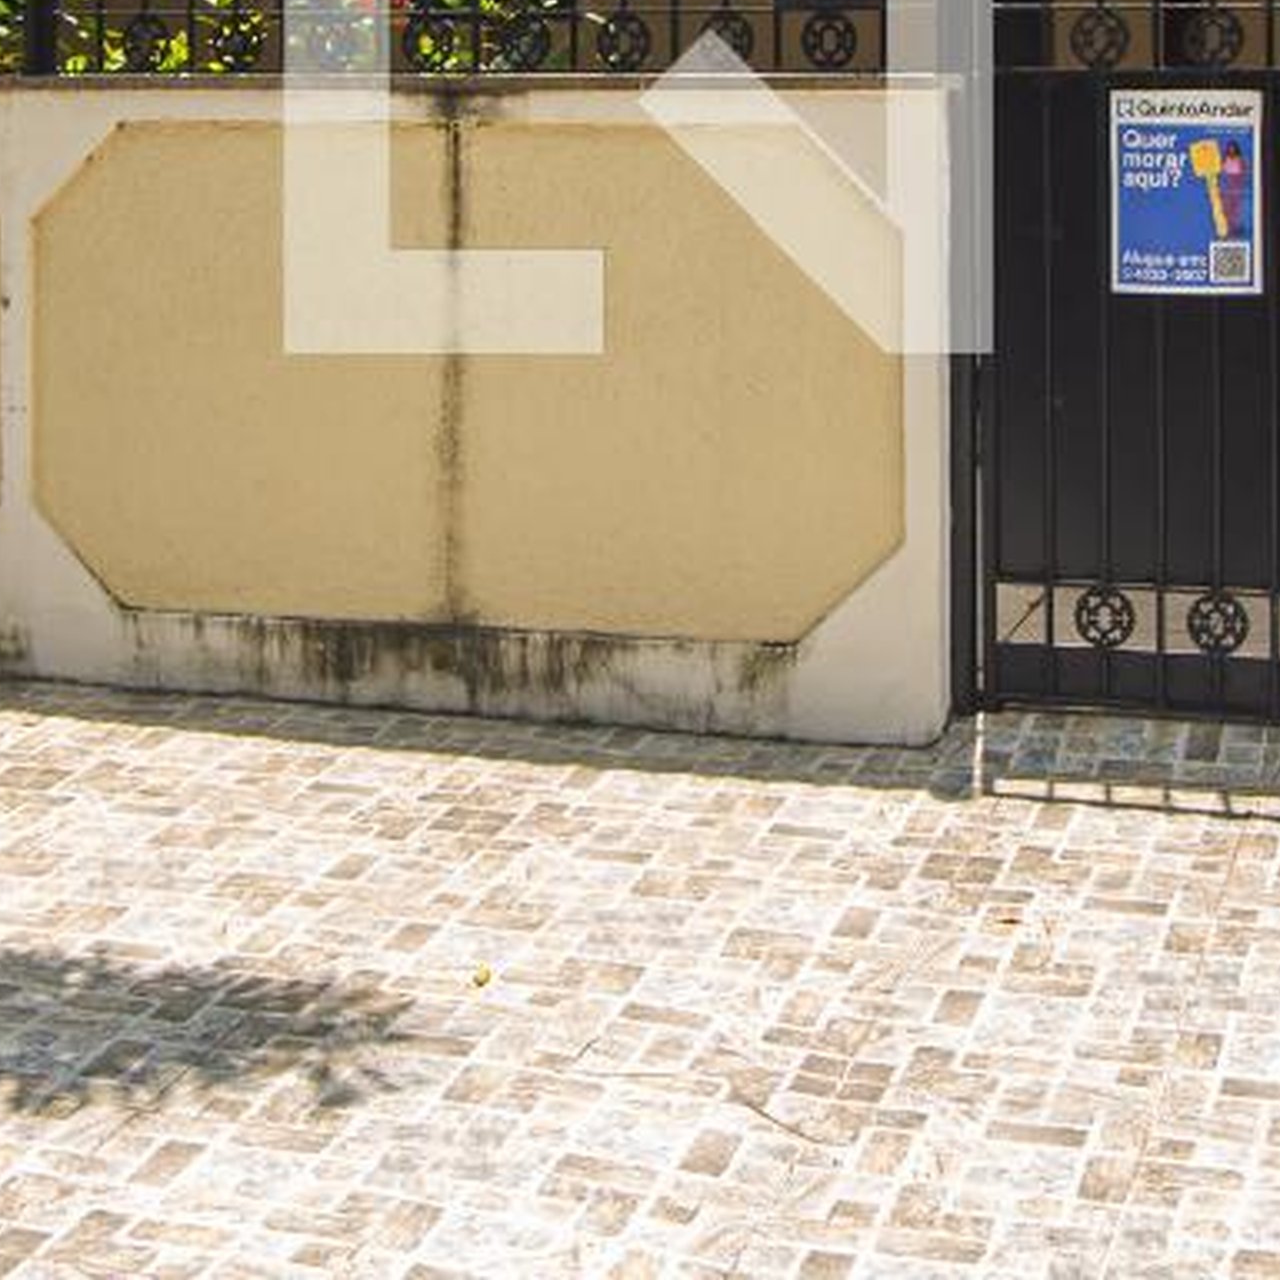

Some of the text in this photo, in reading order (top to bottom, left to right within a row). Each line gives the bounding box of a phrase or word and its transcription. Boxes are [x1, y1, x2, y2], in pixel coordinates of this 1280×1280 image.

[1137, 98, 1254, 117] QuintoAndar
[1122, 129, 1177, 148] Quer
[1123, 152, 1187, 168] morar
[1123, 169, 1182, 191] aqui?
